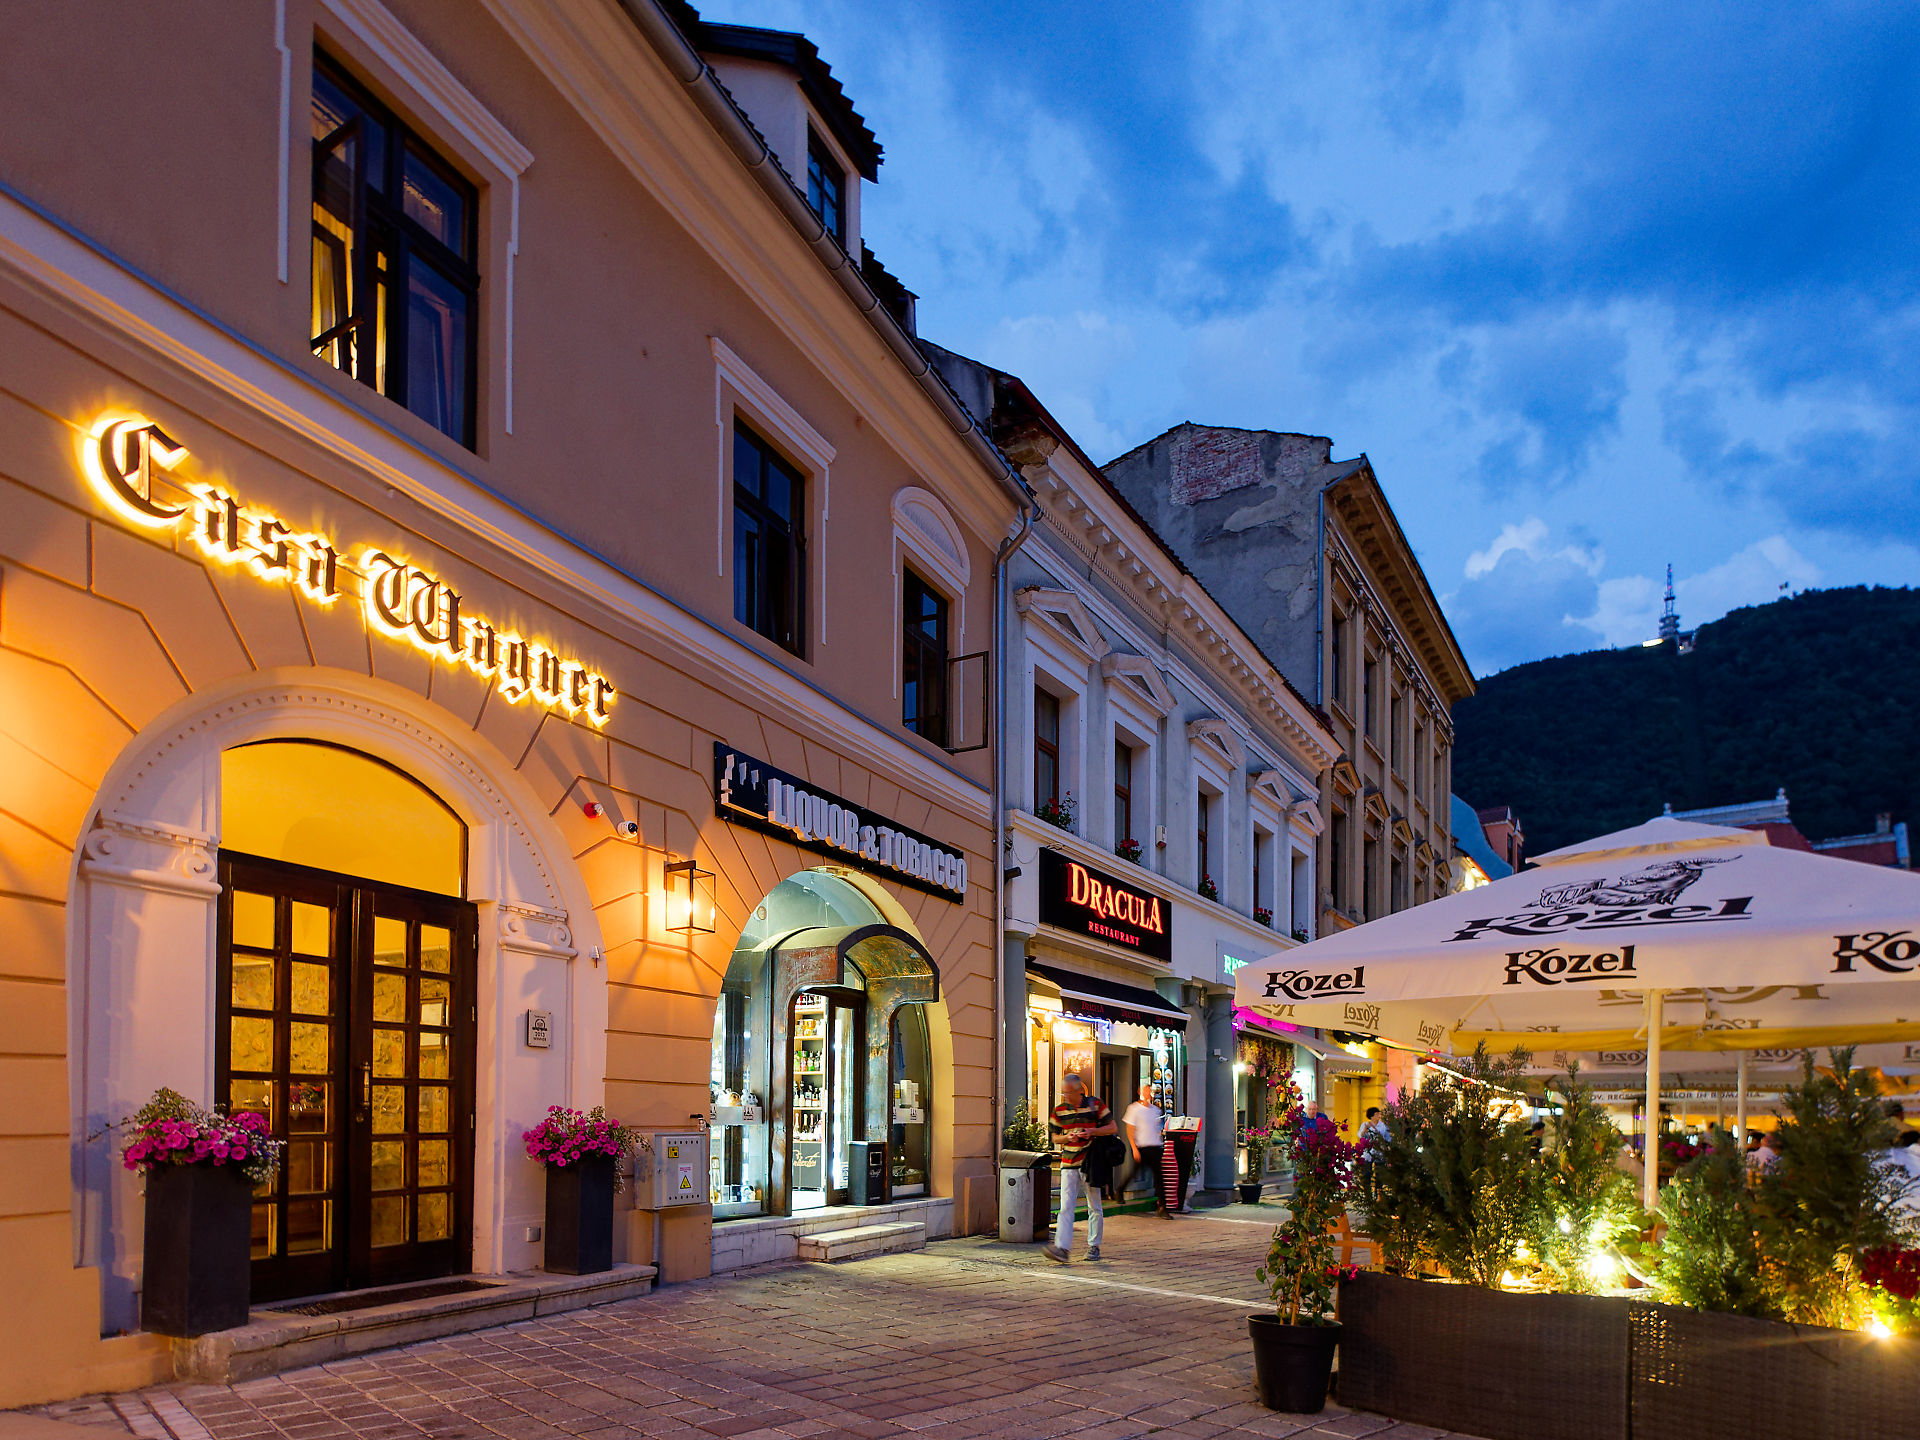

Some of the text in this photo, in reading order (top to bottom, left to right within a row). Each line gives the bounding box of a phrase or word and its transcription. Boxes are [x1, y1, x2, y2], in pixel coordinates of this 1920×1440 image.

[97, 418, 616, 725] Casa Wagner
[768, 778, 859, 854] LIQUOR
[878, 826, 967, 894] TOBACCO
[1068, 862, 1164, 935] DRACULA
[1441, 896, 1753, 943] Kozel
[1088, 920, 1140, 947] RESTAURANT
[1829, 930, 1920, 974] Ko
[1262, 966, 1365, 1000] Kozel
[1503, 945, 1637, 986] Kozel
